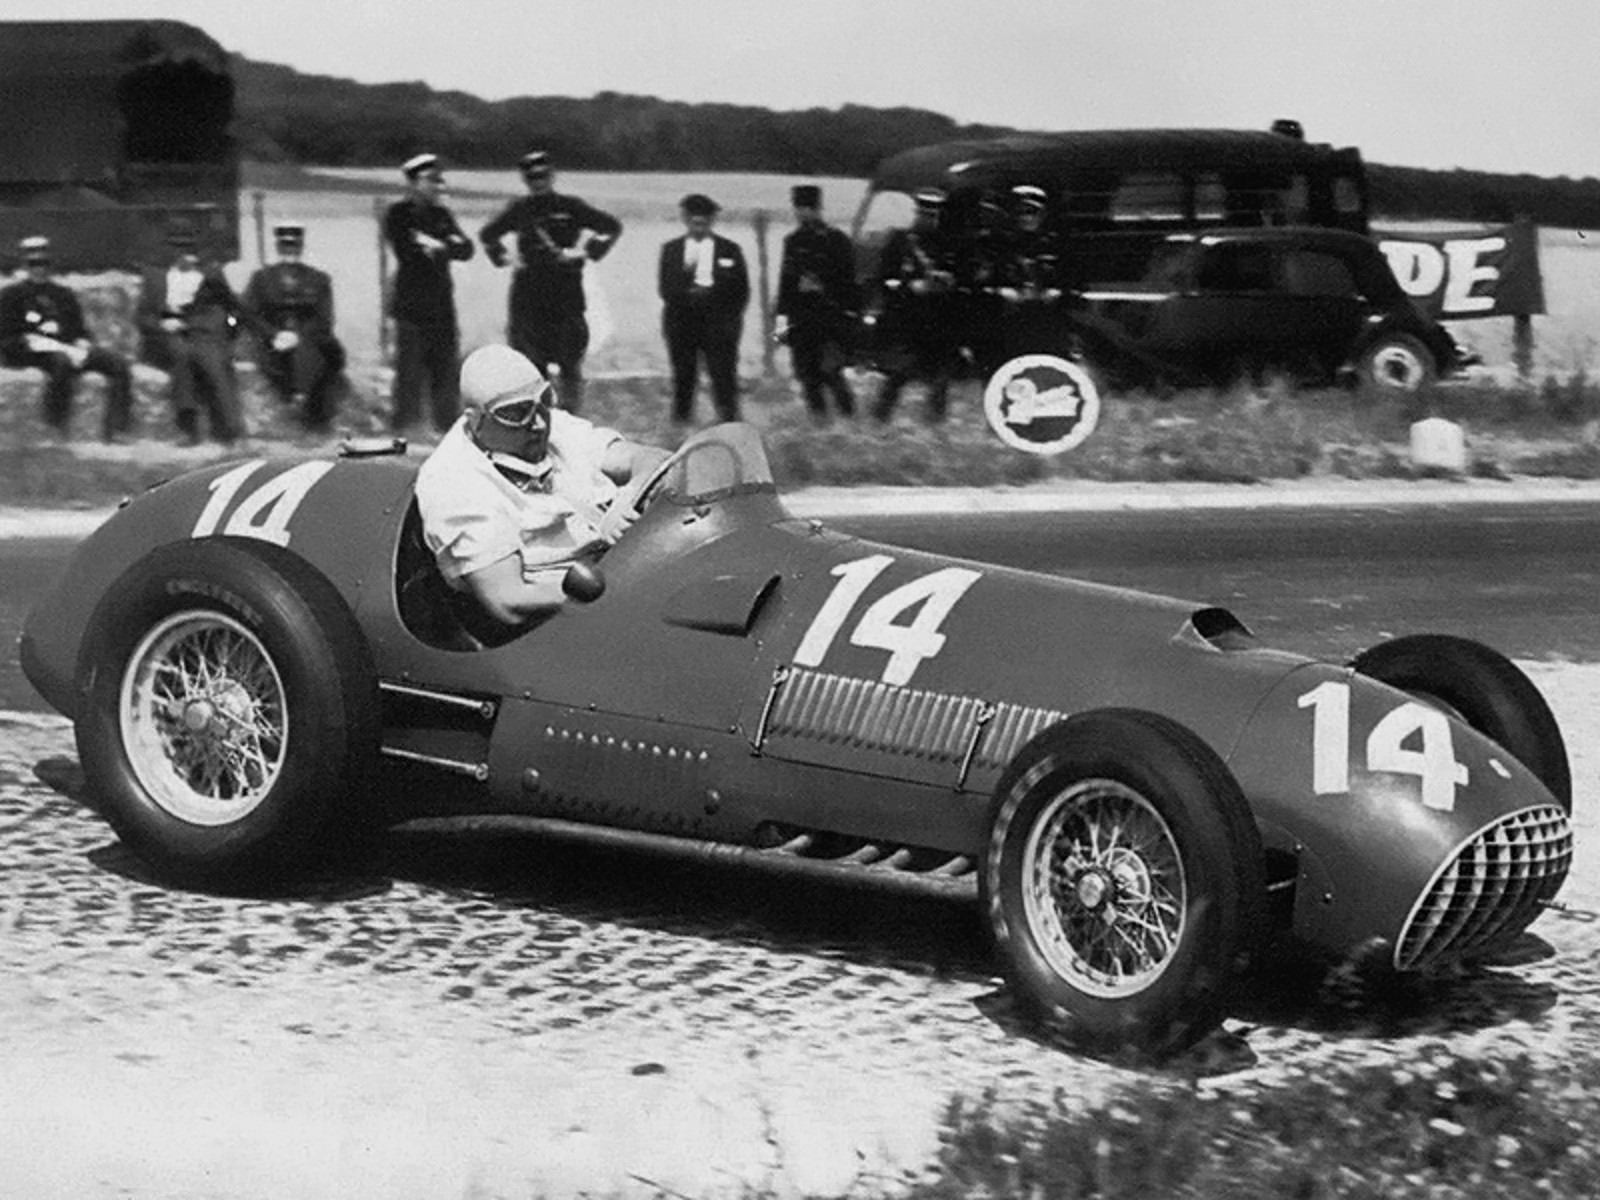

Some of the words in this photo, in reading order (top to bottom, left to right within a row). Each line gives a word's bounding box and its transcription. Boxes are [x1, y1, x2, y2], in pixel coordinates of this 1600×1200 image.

[192, 460, 336, 548] 14
[793, 554, 984, 687] 14
[1297, 681, 1469, 811] 14
